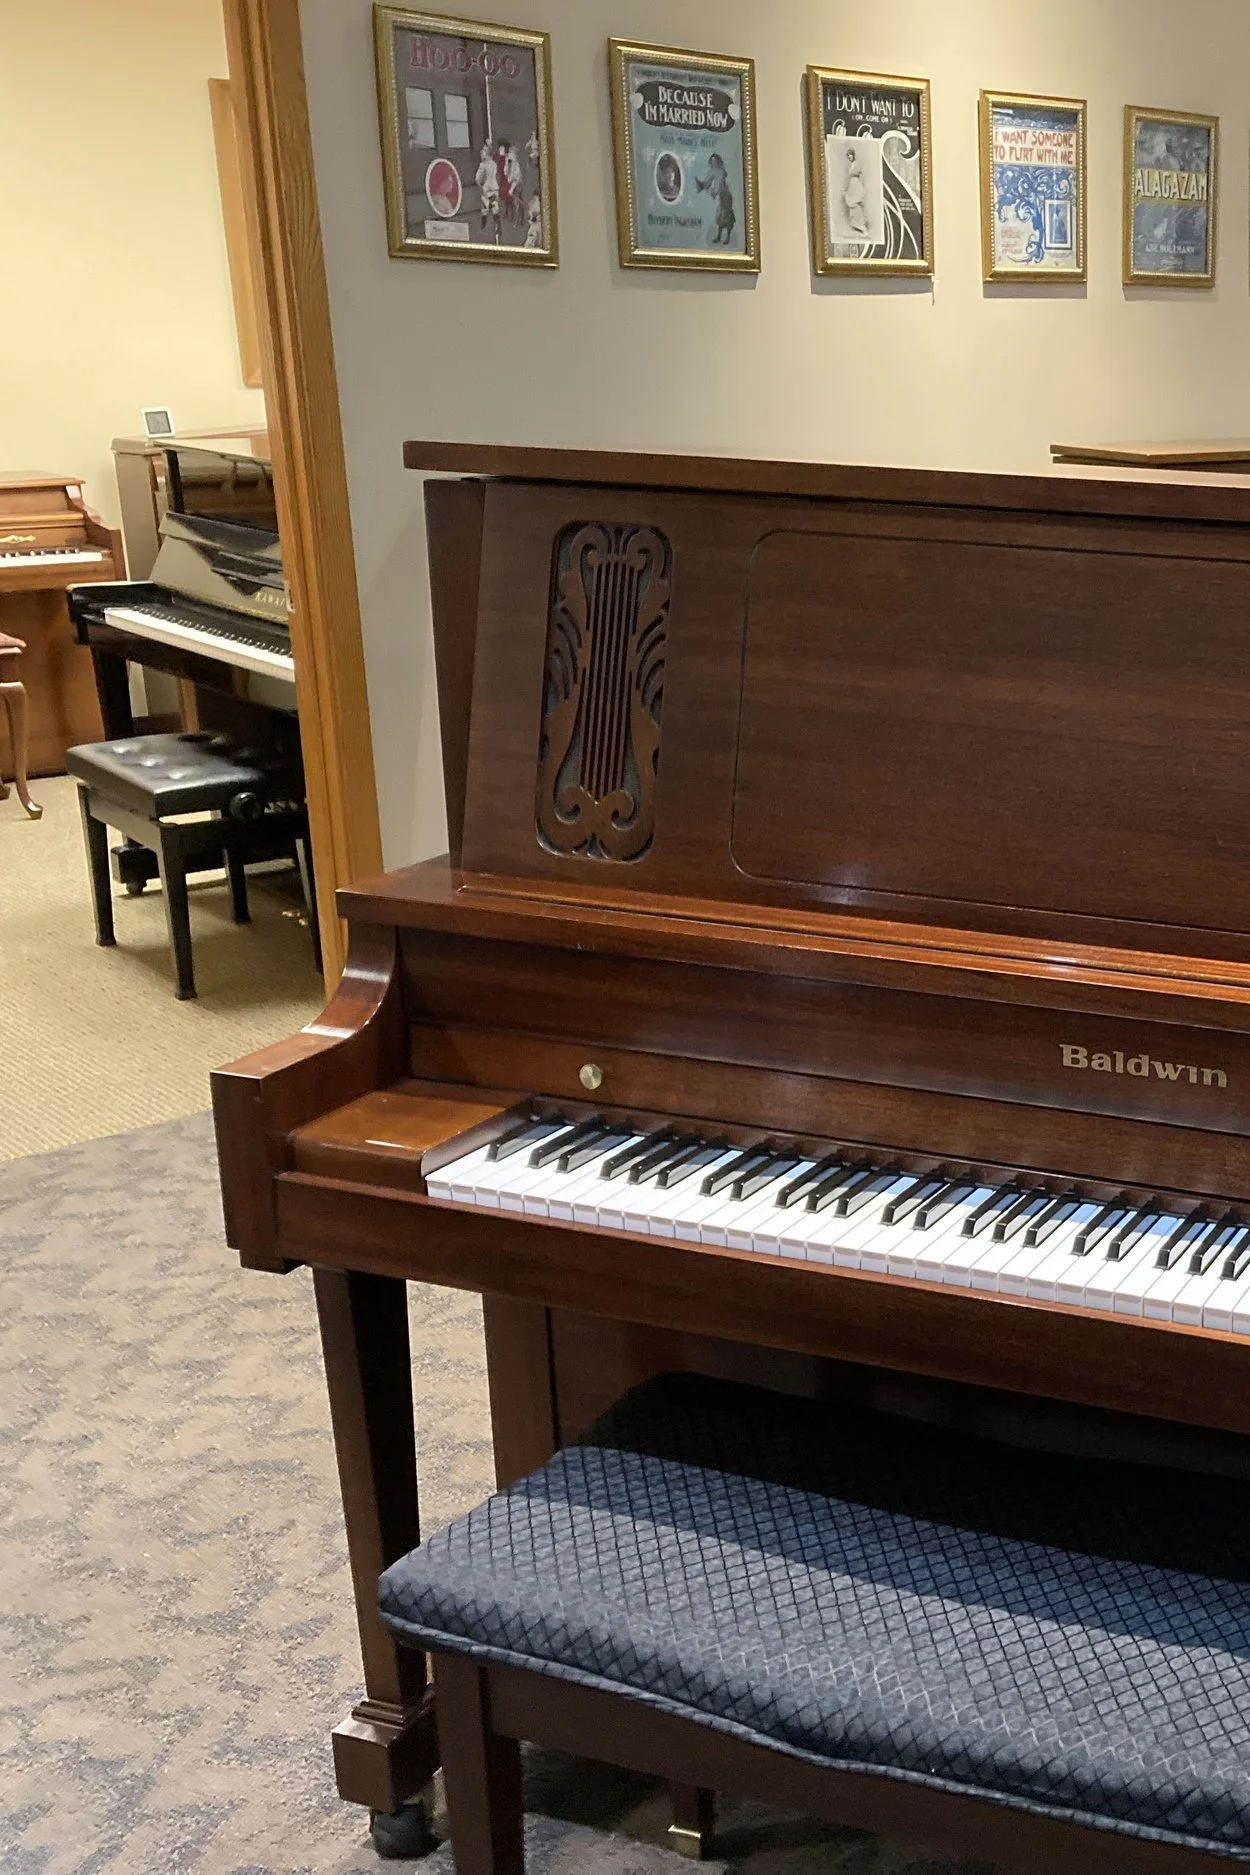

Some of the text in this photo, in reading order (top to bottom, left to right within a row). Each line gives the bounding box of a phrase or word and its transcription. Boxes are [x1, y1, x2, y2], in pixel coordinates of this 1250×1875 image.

[658, 86, 714, 108] BECAUSE
[871, 93, 896, 116] WANT
[900, 98, 914, 118] TO
[659, 104, 705, 125] MARRIED
[706, 109, 728, 128] NOW
[1003, 130, 1028, 144] WANT
[1031, 131, 1073, 148] SOMEONE
[994, 145, 1073, 164] TO FLIRT WITH ME
[1059, 1044, 1228, 1088] Baldwin
